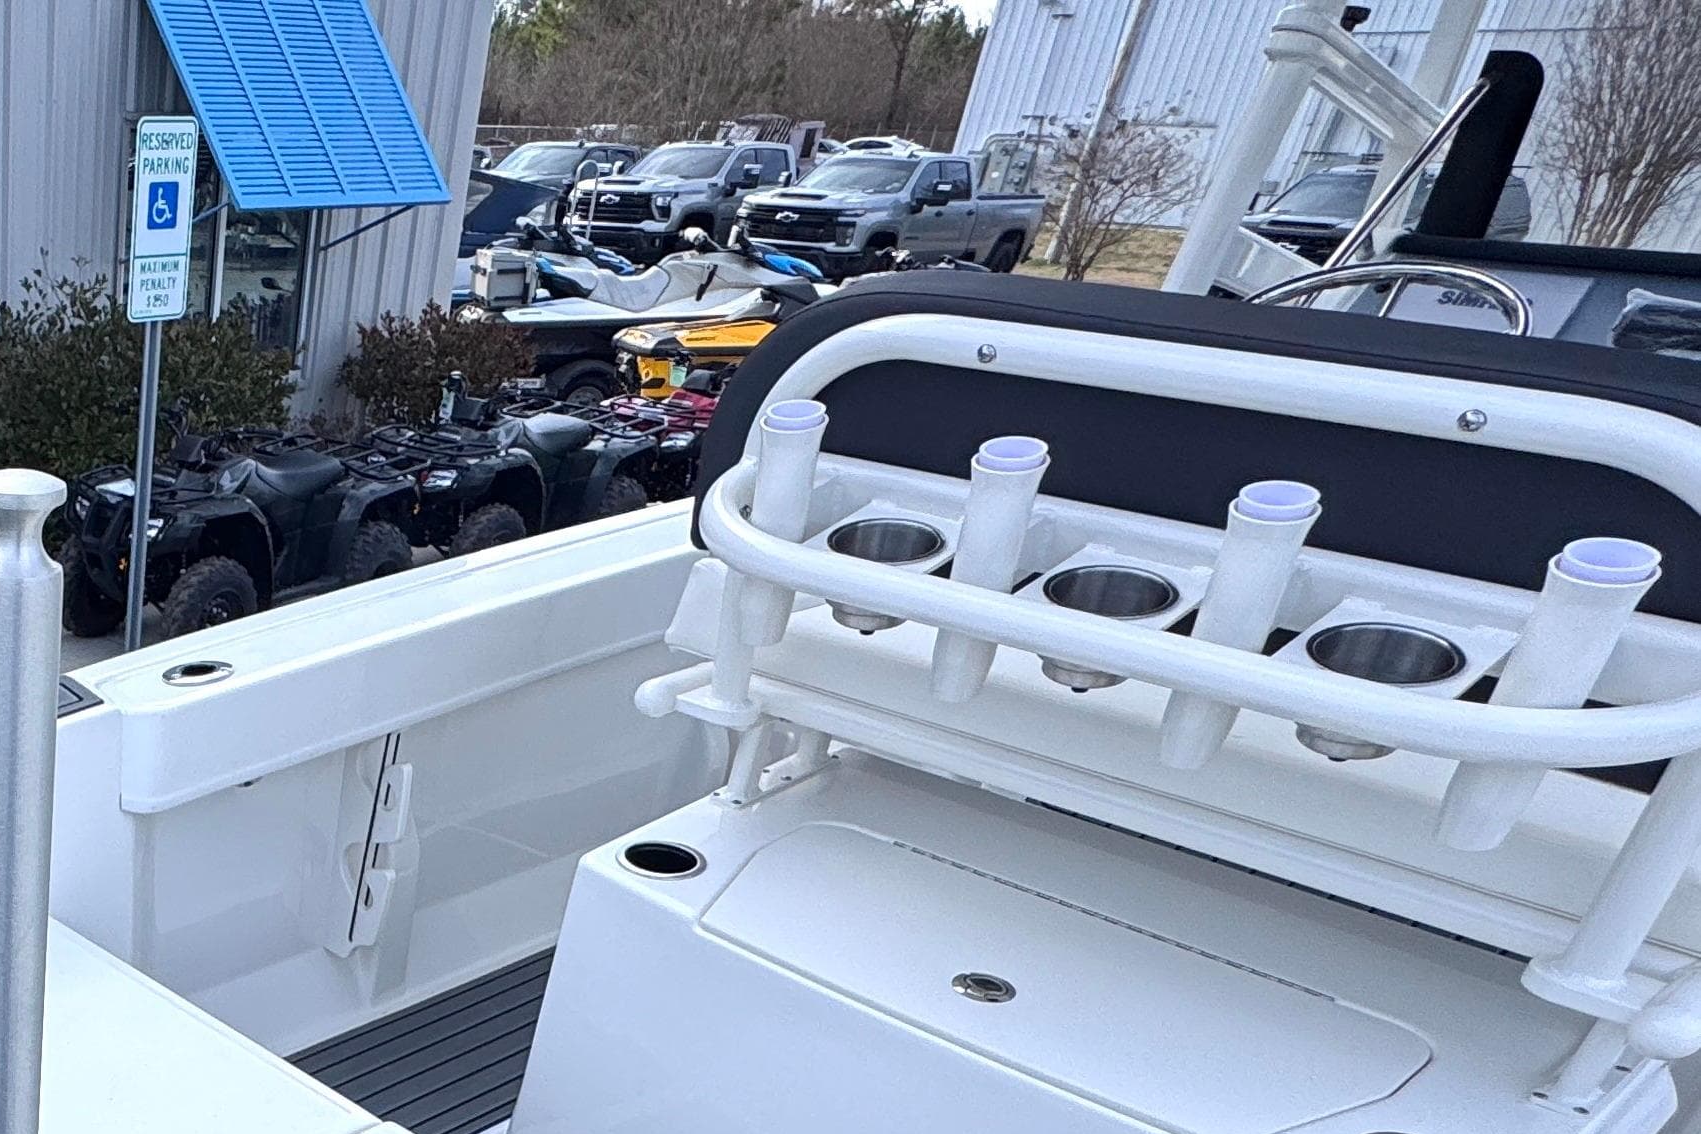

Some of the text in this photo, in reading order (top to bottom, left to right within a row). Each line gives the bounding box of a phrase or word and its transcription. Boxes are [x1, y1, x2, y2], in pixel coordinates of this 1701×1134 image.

[141, 132, 193, 151] RESERVED
[142, 157, 190, 175] PARKING
[140, 259, 180, 274] MAXIMUM
[140, 276, 177, 292] PENALTY
